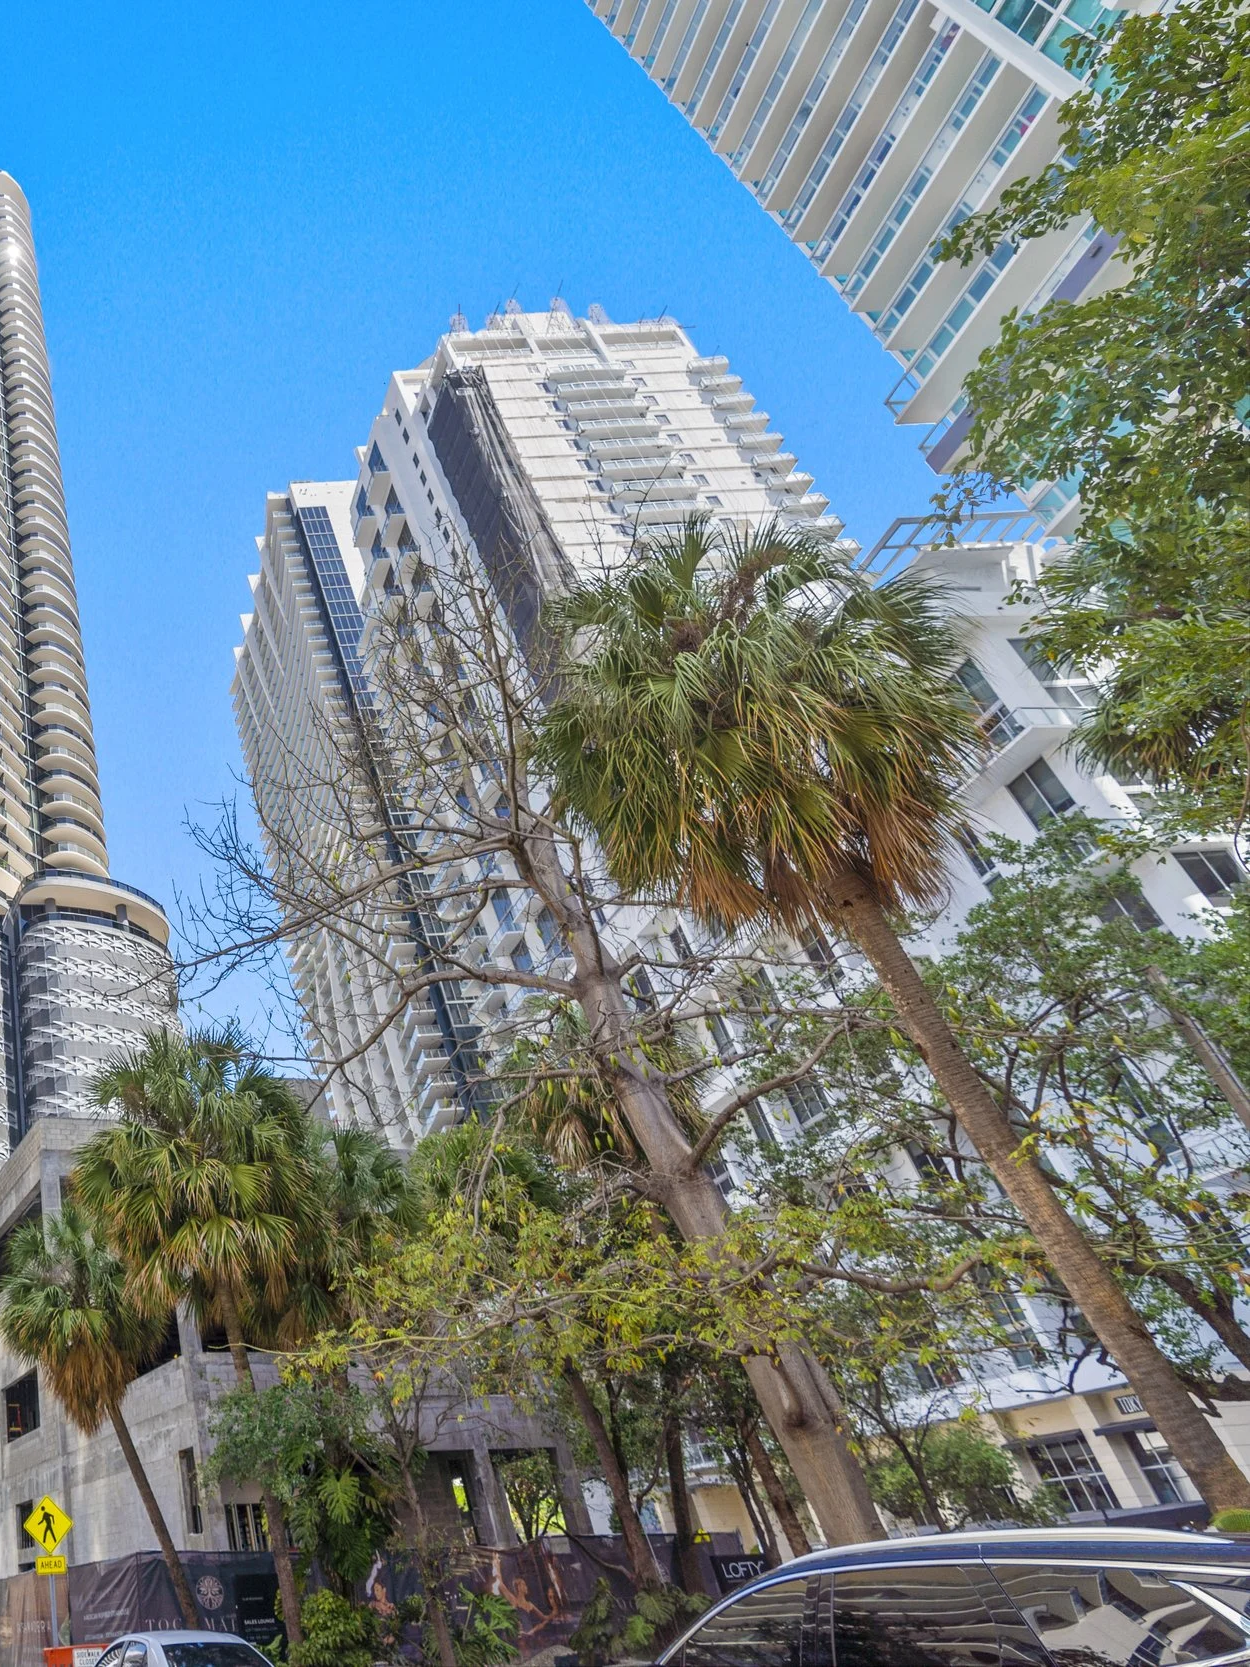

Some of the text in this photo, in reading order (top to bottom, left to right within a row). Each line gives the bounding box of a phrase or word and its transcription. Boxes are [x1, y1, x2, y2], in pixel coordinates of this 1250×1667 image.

[1117, 1395, 1144, 1413] TOKY
[41, 1560, 62, 1569] AHEAD
[721, 1561, 764, 1578] LOFTY
